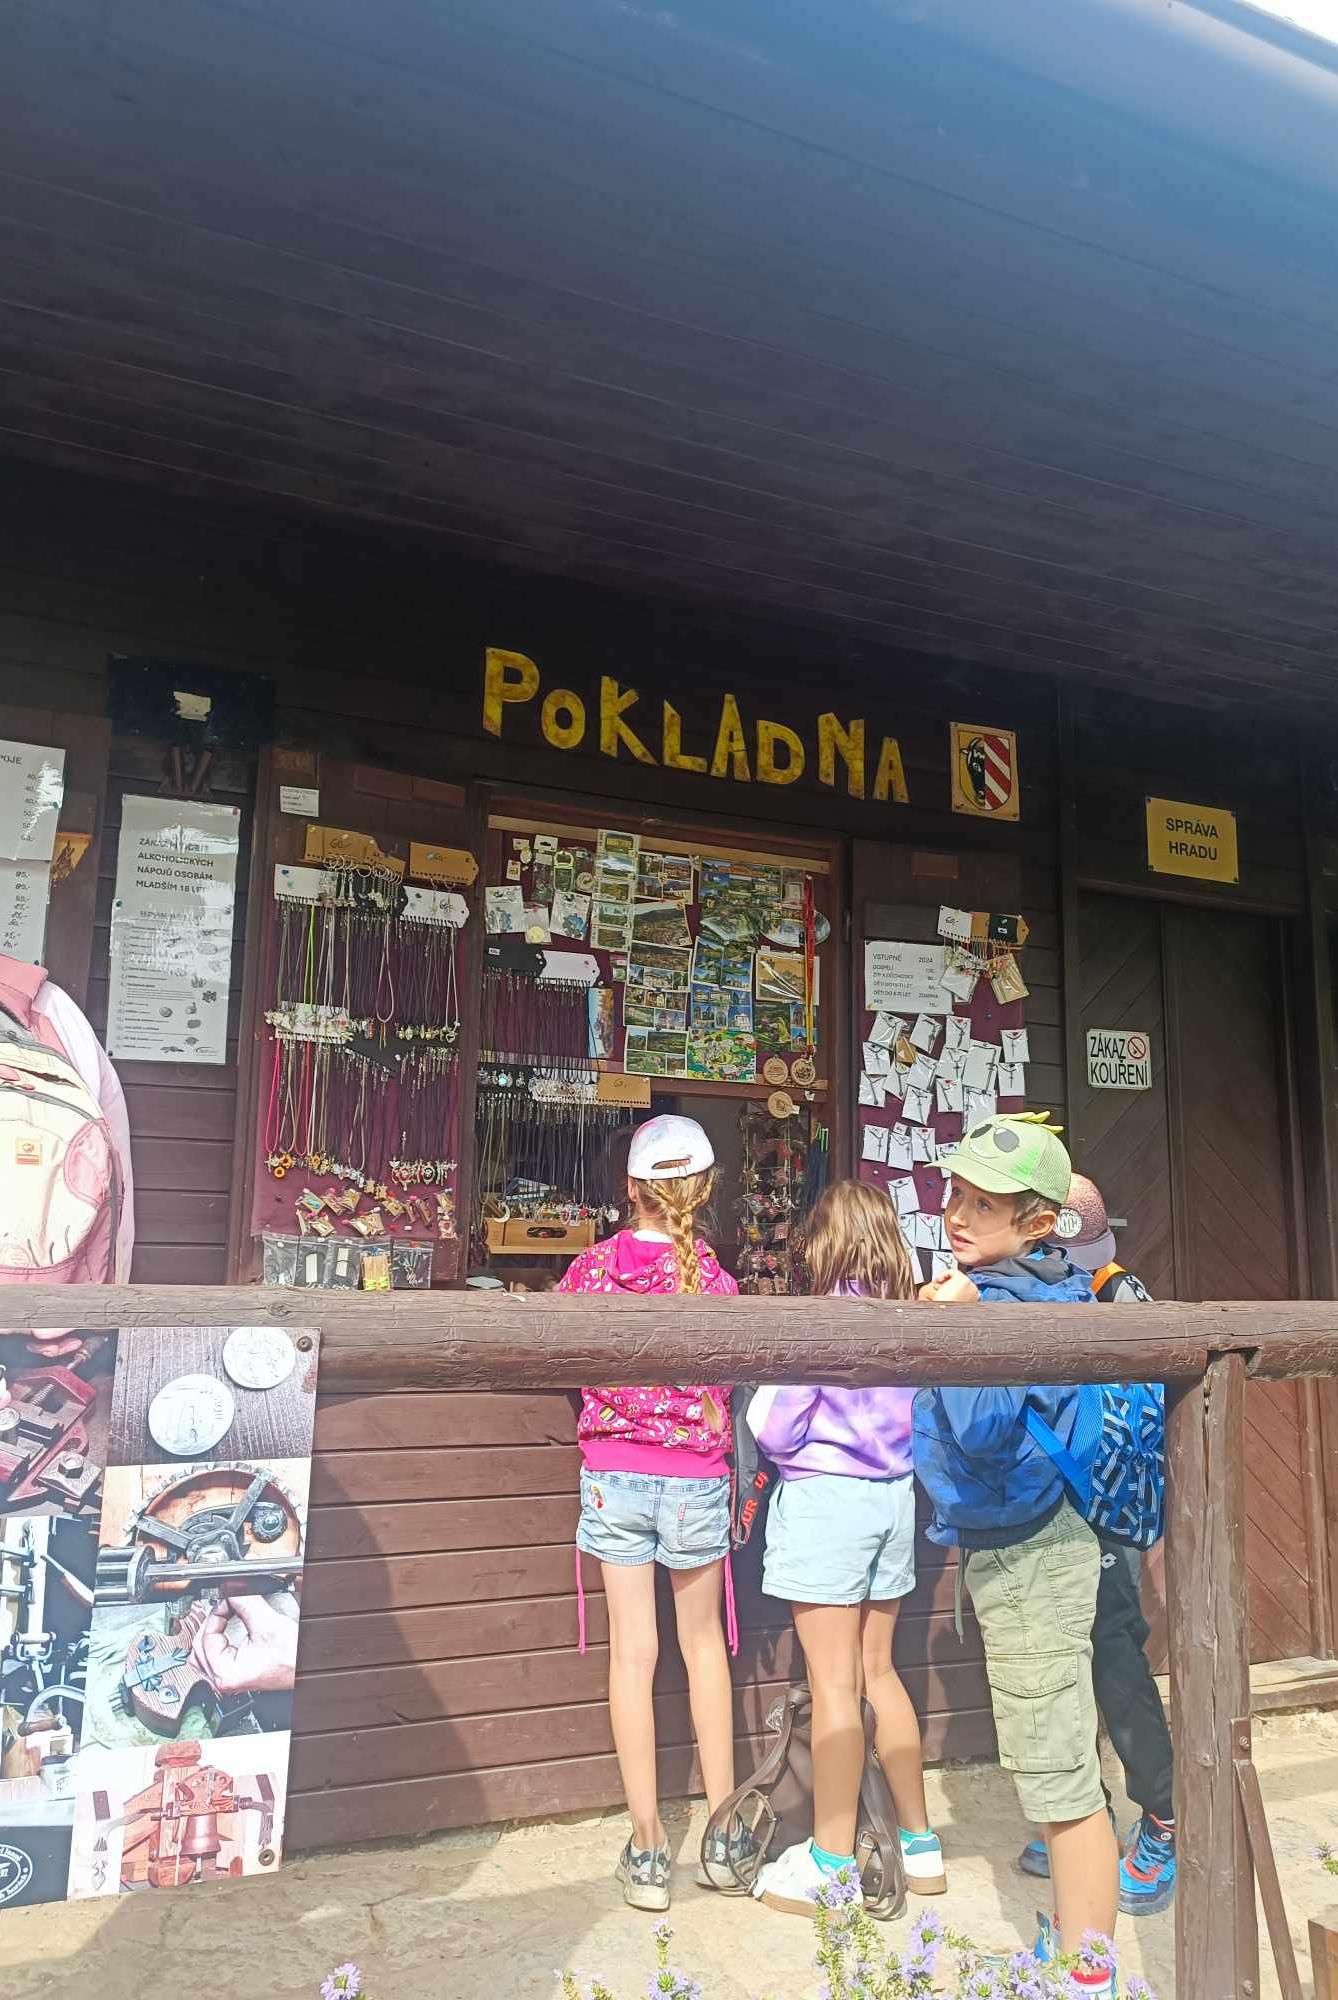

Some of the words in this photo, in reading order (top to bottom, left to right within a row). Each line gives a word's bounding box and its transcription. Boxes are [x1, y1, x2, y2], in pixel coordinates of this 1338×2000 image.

[1166, 817, 1219, 840] SPRÁVA
[1168, 841, 1218, 861] HRADU
[137, 865, 173, 876] NÁPOJŮ
[174, 870, 213, 880] OSOBÁM
[136, 879, 177, 891] MLADŠÍM
[1090, 1035, 1127, 1060] ZÁKAZ
[1090, 1059, 1148, 1086] KOUŘENÍ
